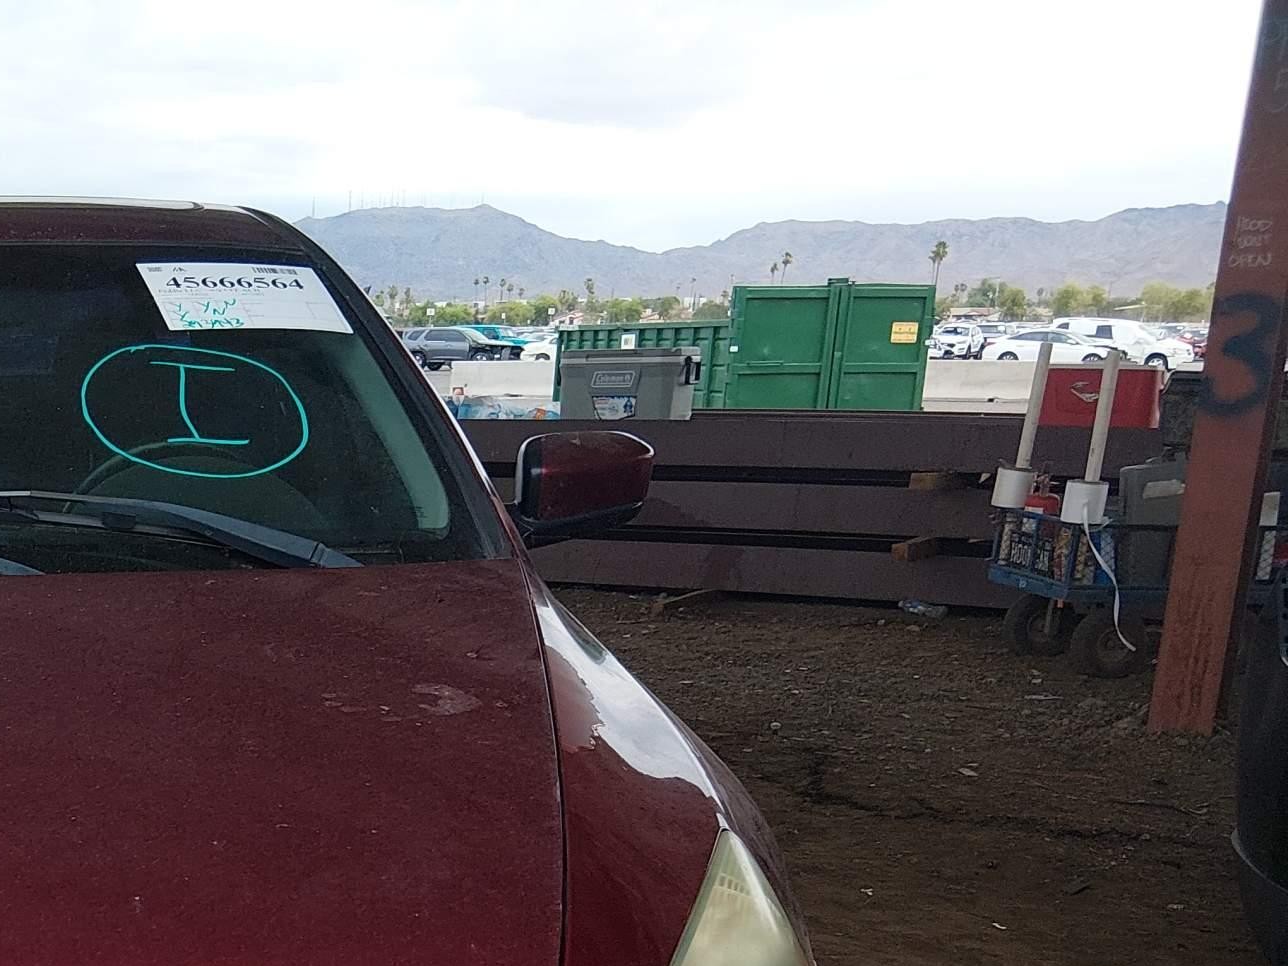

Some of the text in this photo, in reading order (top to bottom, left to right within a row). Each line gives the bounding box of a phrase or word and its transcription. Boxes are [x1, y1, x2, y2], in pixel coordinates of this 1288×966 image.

[166, 275, 305, 291] 45666564
[1192, 290, 1282, 417] 3
[149, 361, 251, 445] I
